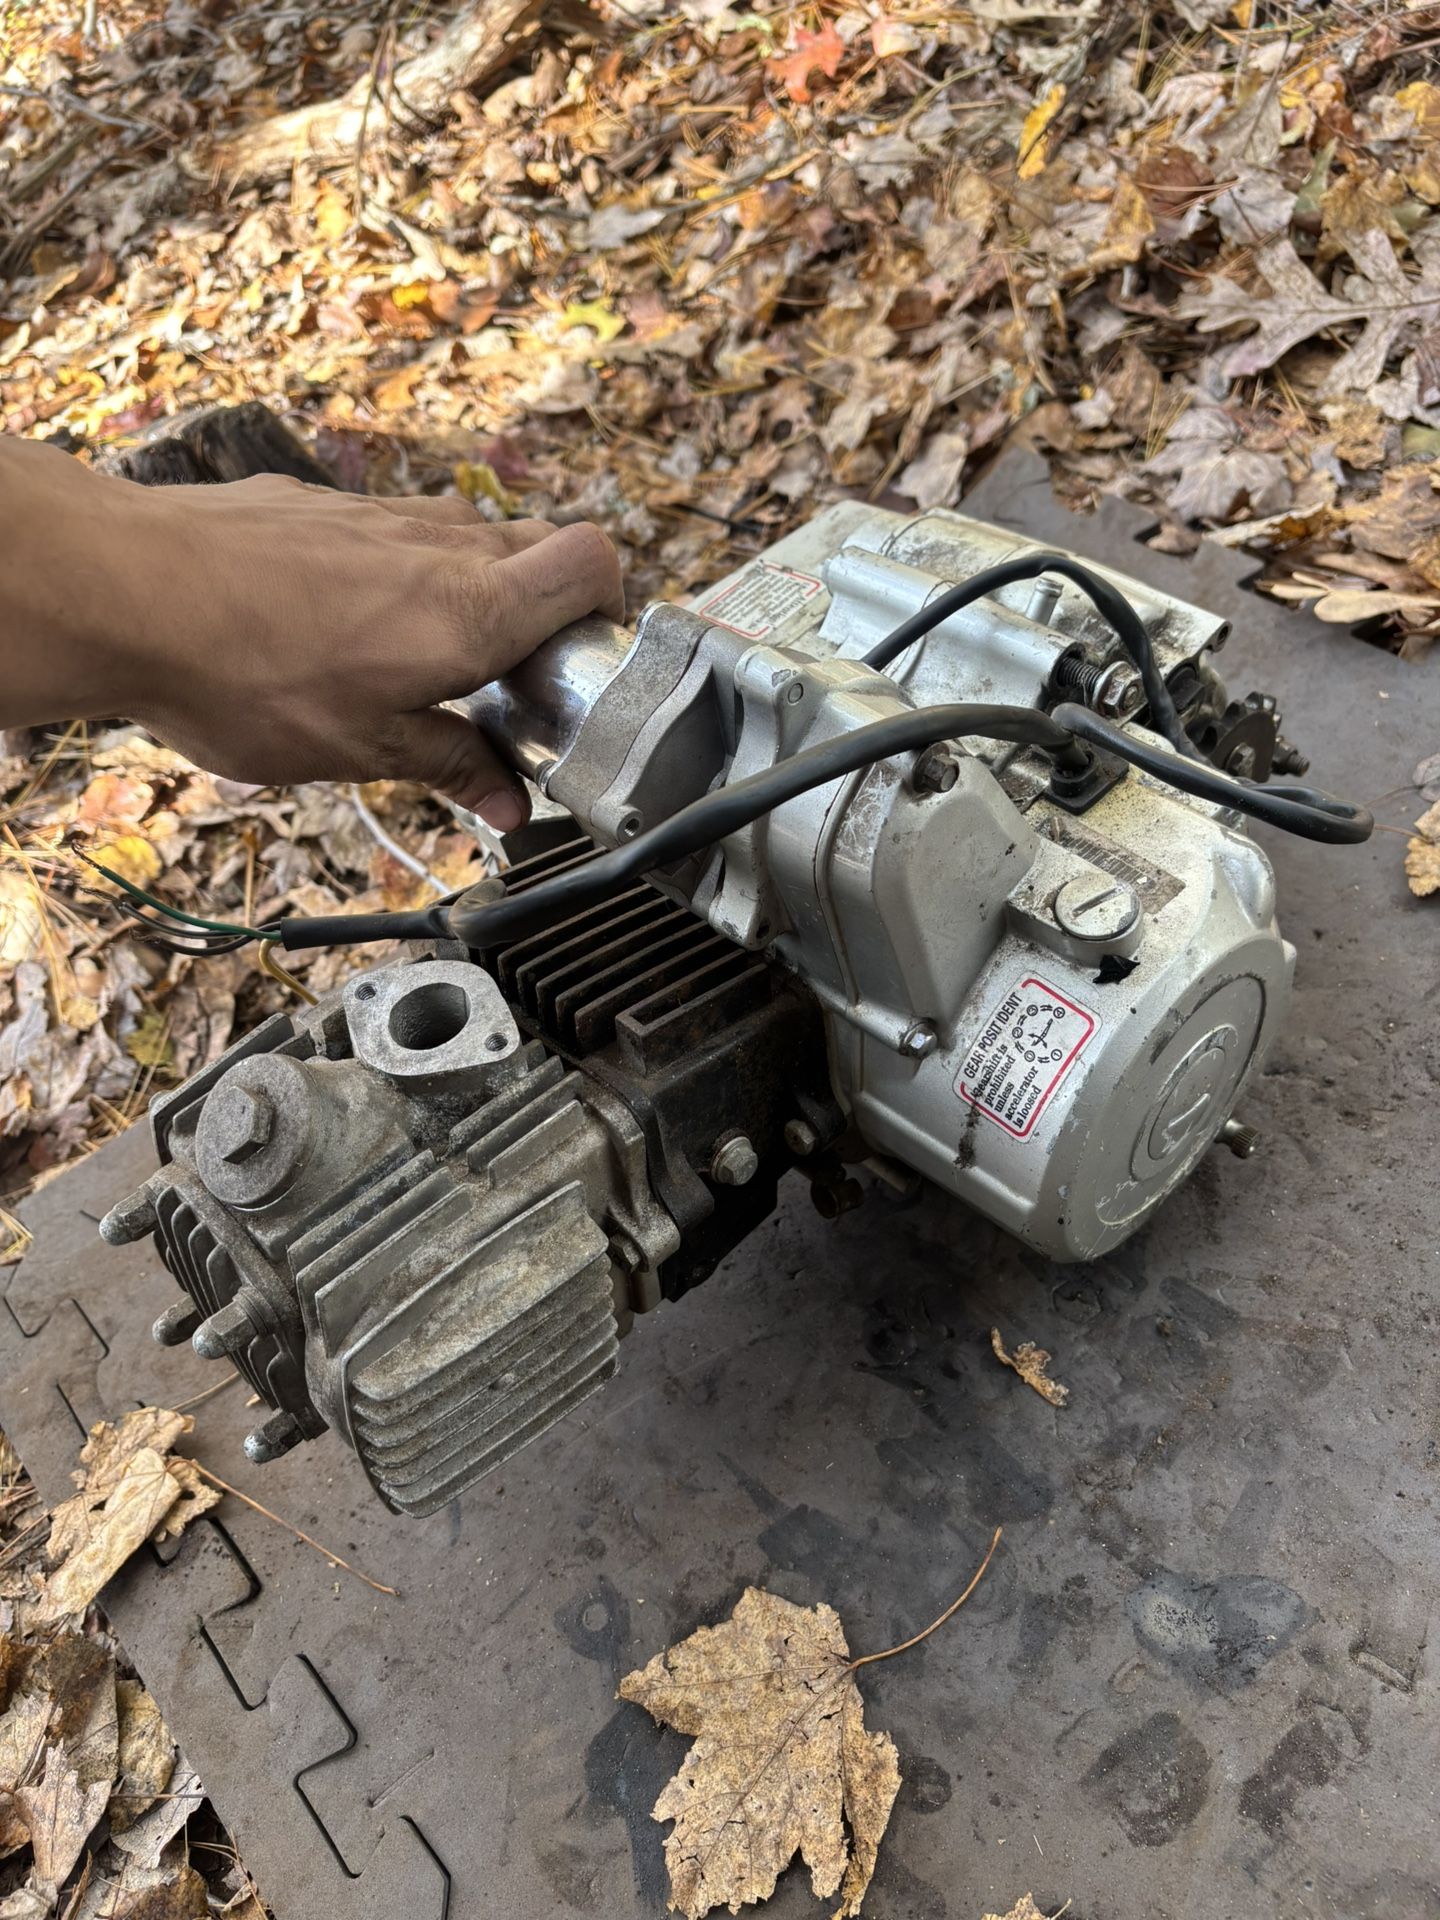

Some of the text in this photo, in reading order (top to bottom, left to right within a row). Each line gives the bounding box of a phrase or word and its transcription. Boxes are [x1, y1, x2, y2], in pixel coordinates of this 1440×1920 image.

[964, 992, 1023, 1079] GEAR POSIT IDENT
[999, 1043, 1008, 1056] is
[983, 1054, 1016, 1108] prohibited
[994, 1081, 1015, 1113] unless
[1004, 1066, 1039, 1121] accelerator
[1013, 1084, 1042, 1129] is loosed
